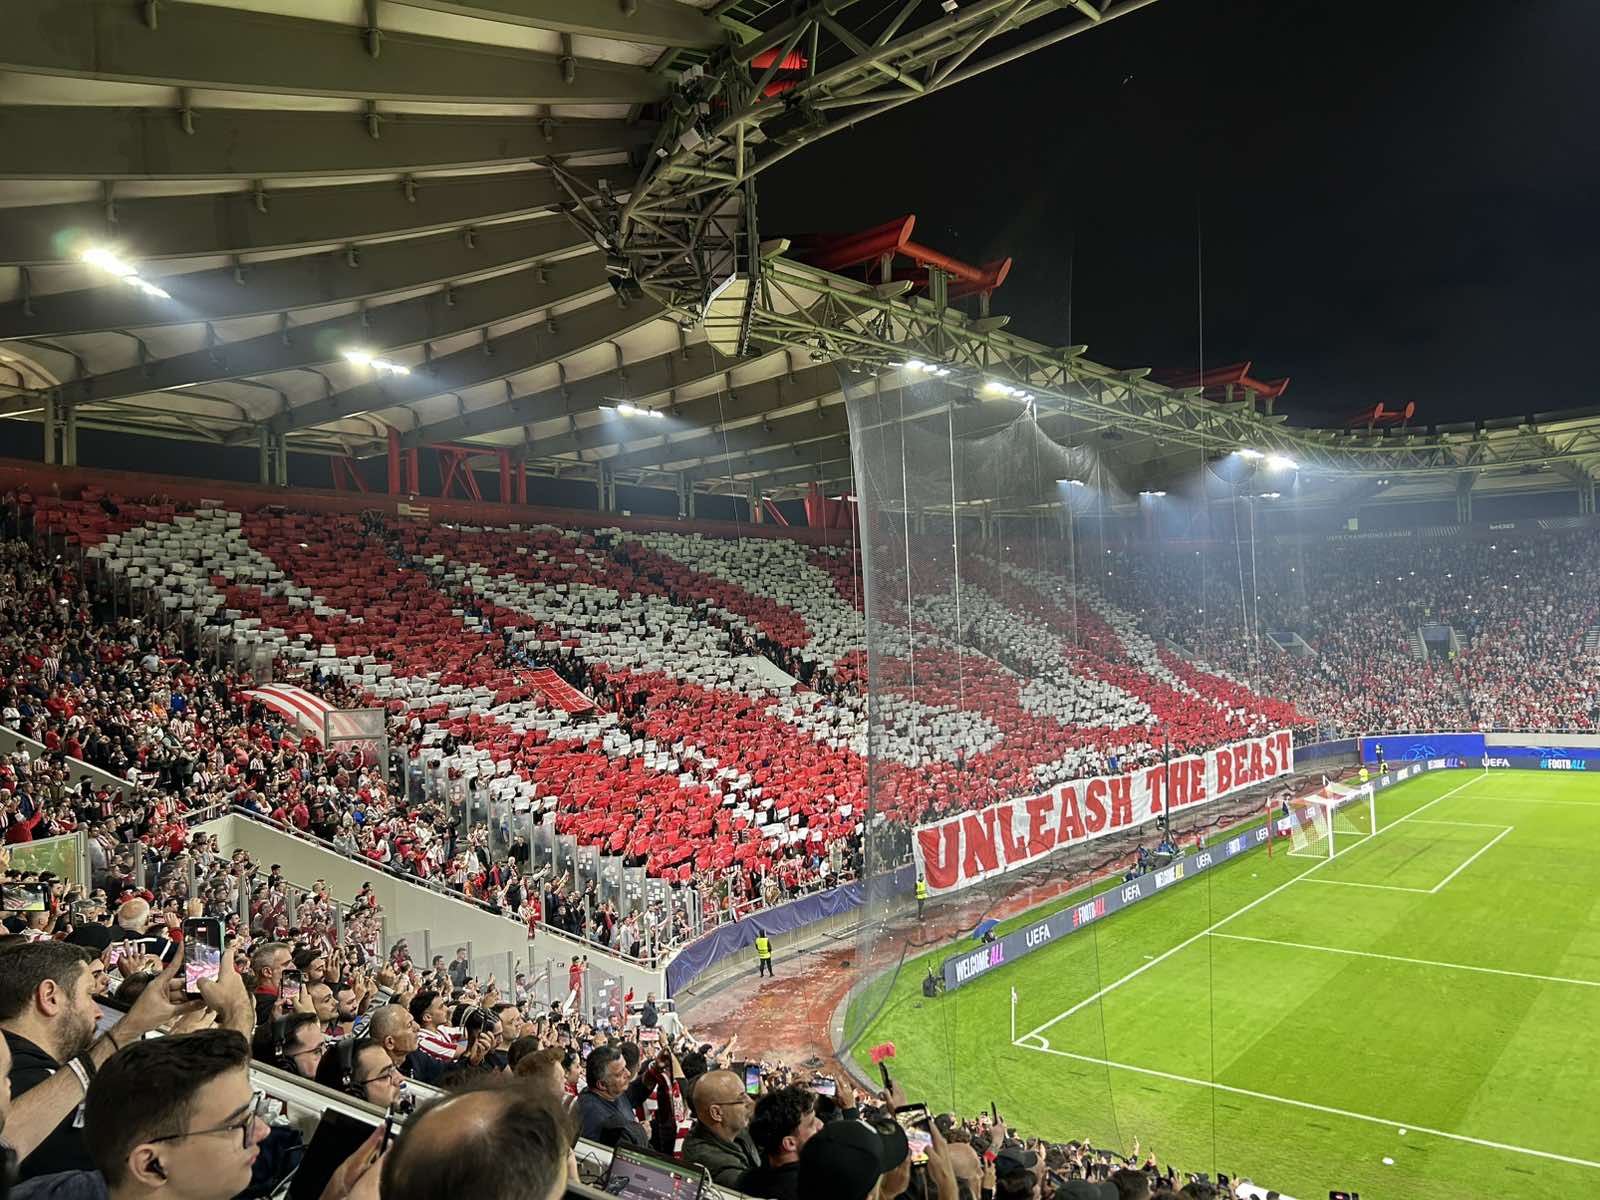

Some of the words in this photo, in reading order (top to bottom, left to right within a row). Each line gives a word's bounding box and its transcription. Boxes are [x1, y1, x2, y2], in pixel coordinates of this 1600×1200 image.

[1482, 758, 1510, 768] UEFA
[1540, 758, 1586, 770] #FOOTBALL
[917, 776, 1133, 889] UNLEASH
[1146, 758, 1206, 814] THE
[1216, 733, 1291, 794] BEAST
[1196, 852, 1213, 869] UEFA
[1122, 883, 1141, 903] UEFA
[1072, 897, 1105, 928] #FOOTBALL
[1026, 923, 1051, 948] UEFA
